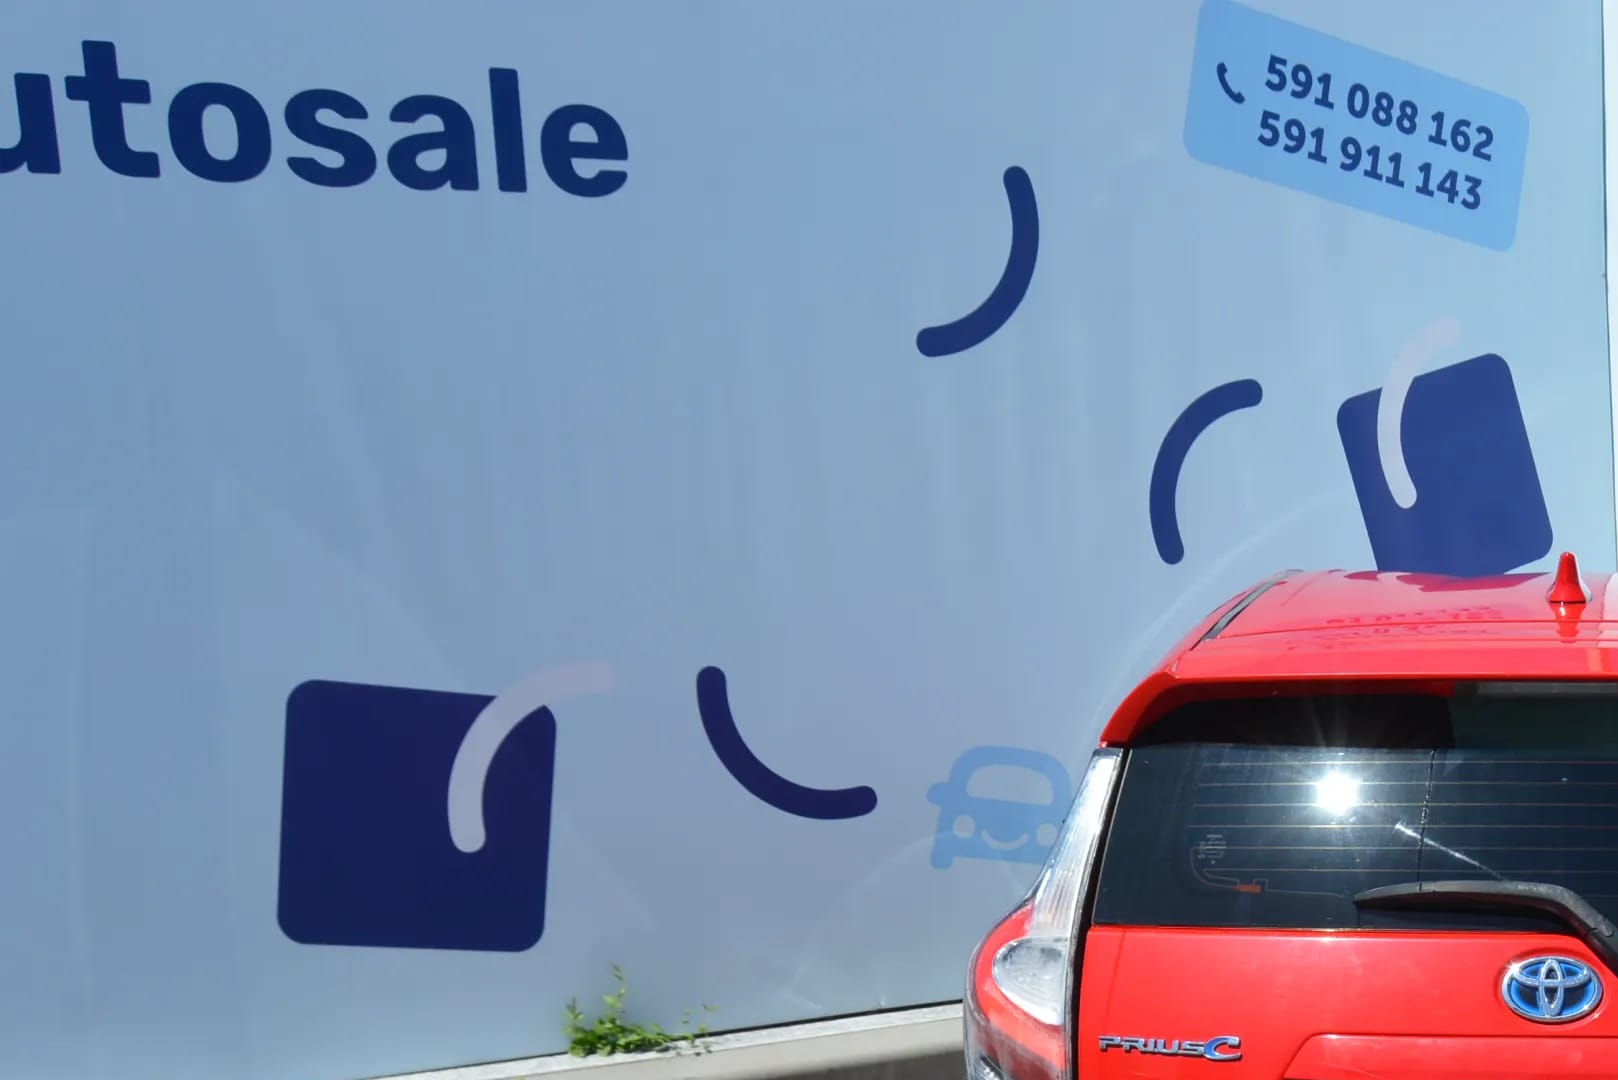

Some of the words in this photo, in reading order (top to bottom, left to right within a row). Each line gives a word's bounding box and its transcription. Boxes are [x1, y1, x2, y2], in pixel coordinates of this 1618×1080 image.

[1265, 53, 1335, 110] 591
[1346, 82, 1419, 136] 088
[1428, 110, 1494, 162] 162
[1257, 109, 1328, 164] 591
[1339, 136, 1405, 189] 911
[1415, 161, 1483, 211] 143
[1098, 1035, 1204, 1056] PRIUS
